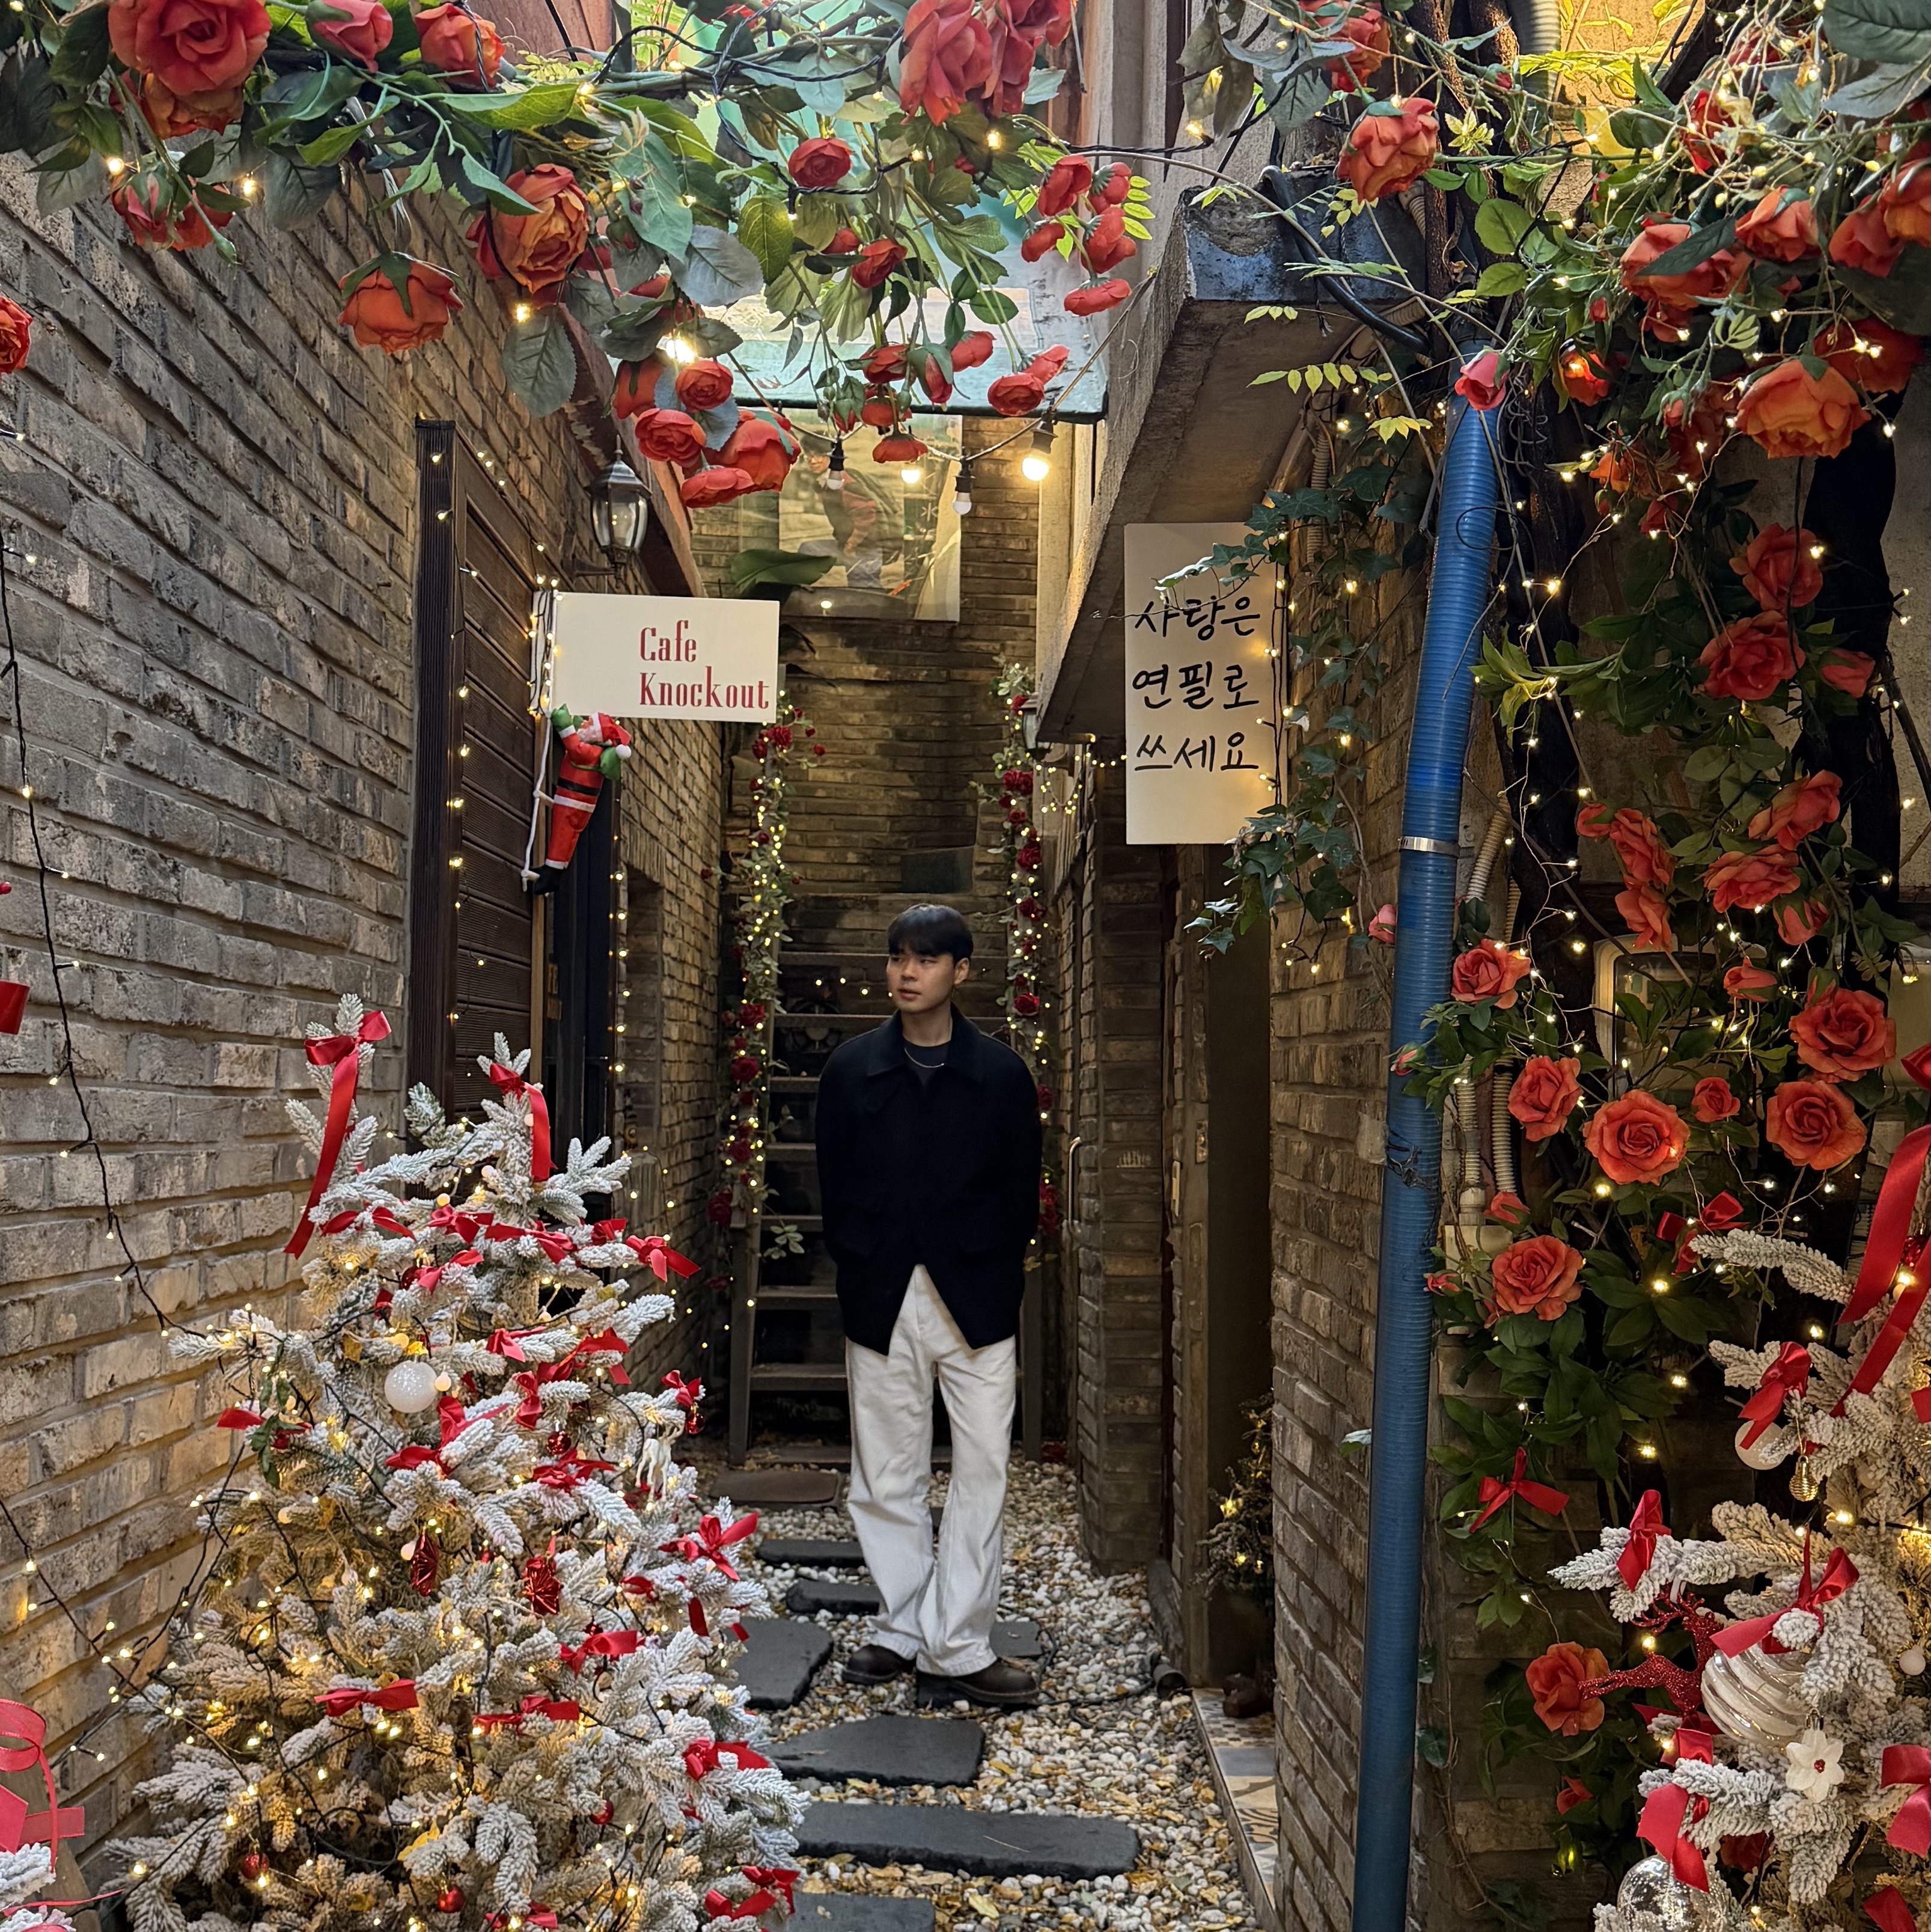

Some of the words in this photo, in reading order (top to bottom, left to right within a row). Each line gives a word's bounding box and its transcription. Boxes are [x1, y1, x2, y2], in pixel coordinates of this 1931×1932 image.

[1135, 595, 1260, 641] 사랑은
[639, 619, 697, 662] Cafe
[639, 665, 769, 709] Knockout
[1132, 661, 1260, 710] 연필로
[1134, 732, 1259, 772] 쓰세요
